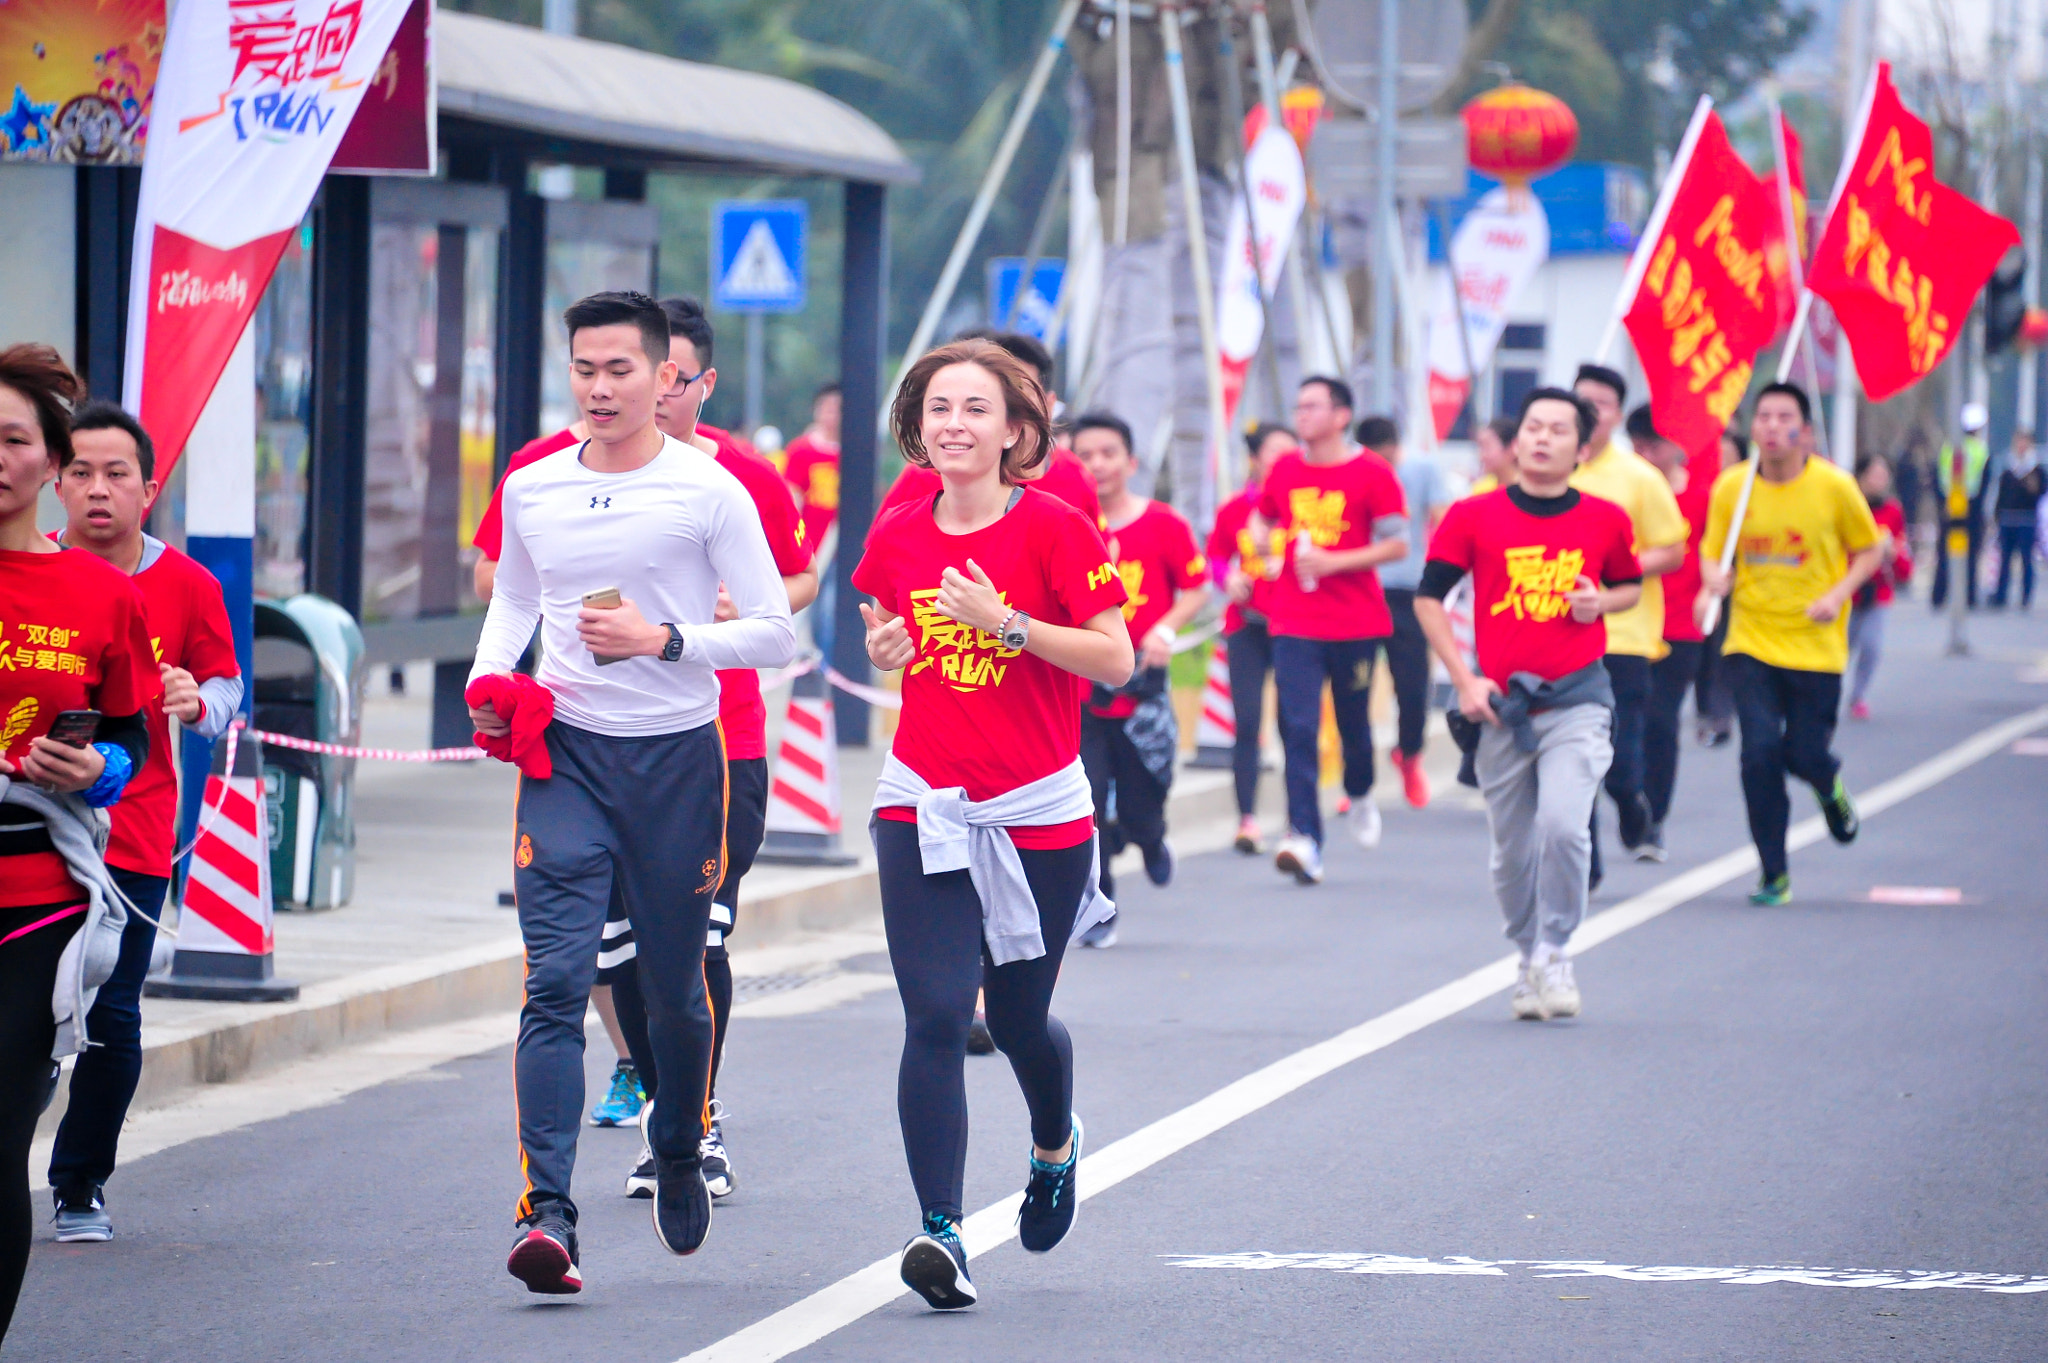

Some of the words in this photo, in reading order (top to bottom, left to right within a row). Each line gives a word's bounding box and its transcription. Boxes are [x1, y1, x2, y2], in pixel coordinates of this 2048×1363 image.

[12, 646, 88, 676] 与爱同行
[941, 653, 1007, 688] RUN
